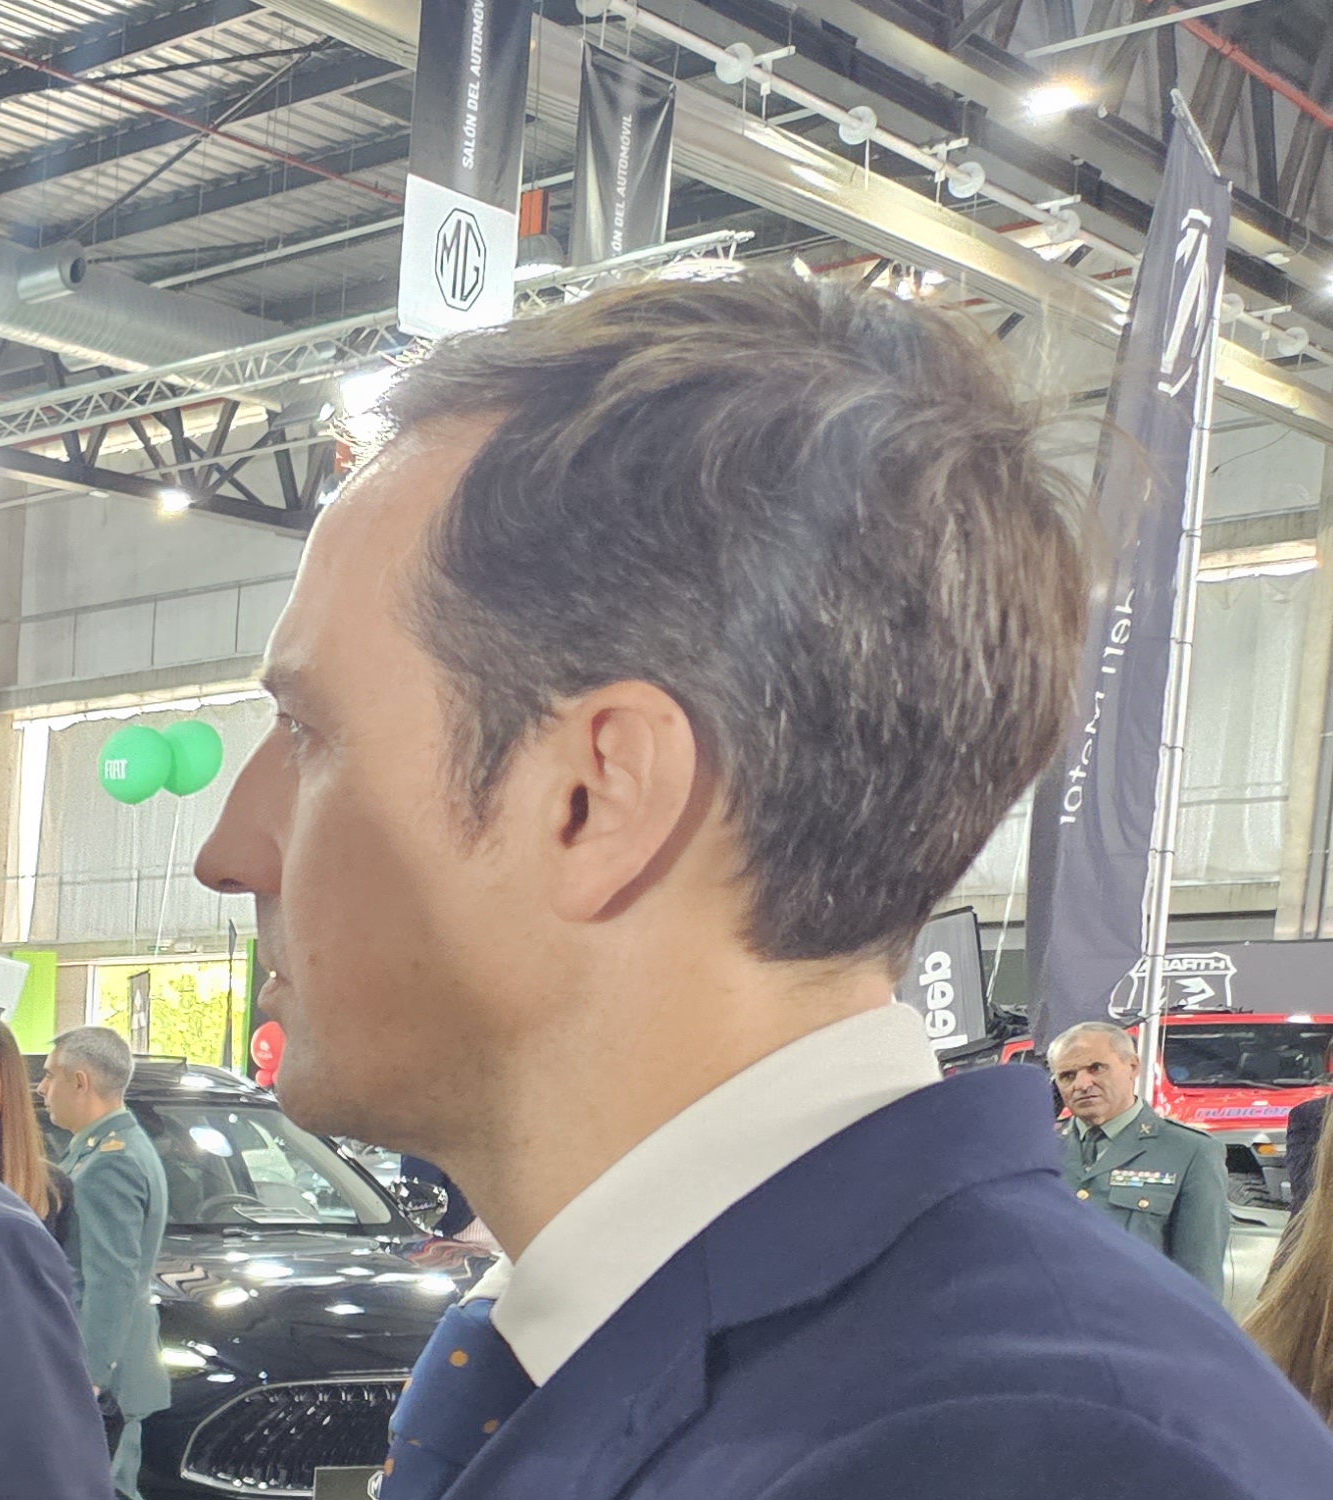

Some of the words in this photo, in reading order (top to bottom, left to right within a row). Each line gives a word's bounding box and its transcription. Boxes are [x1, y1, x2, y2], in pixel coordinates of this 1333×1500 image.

[470, 0, 484, 78] AUTOMÓV
[467, 81, 480, 112] DEL
[462, 114, 478, 170] SALÓN
[616, 113, 632, 198] AUTOMÓVIL
[614, 200, 626, 226] DEL
[439, 217, 482, 303] MG
